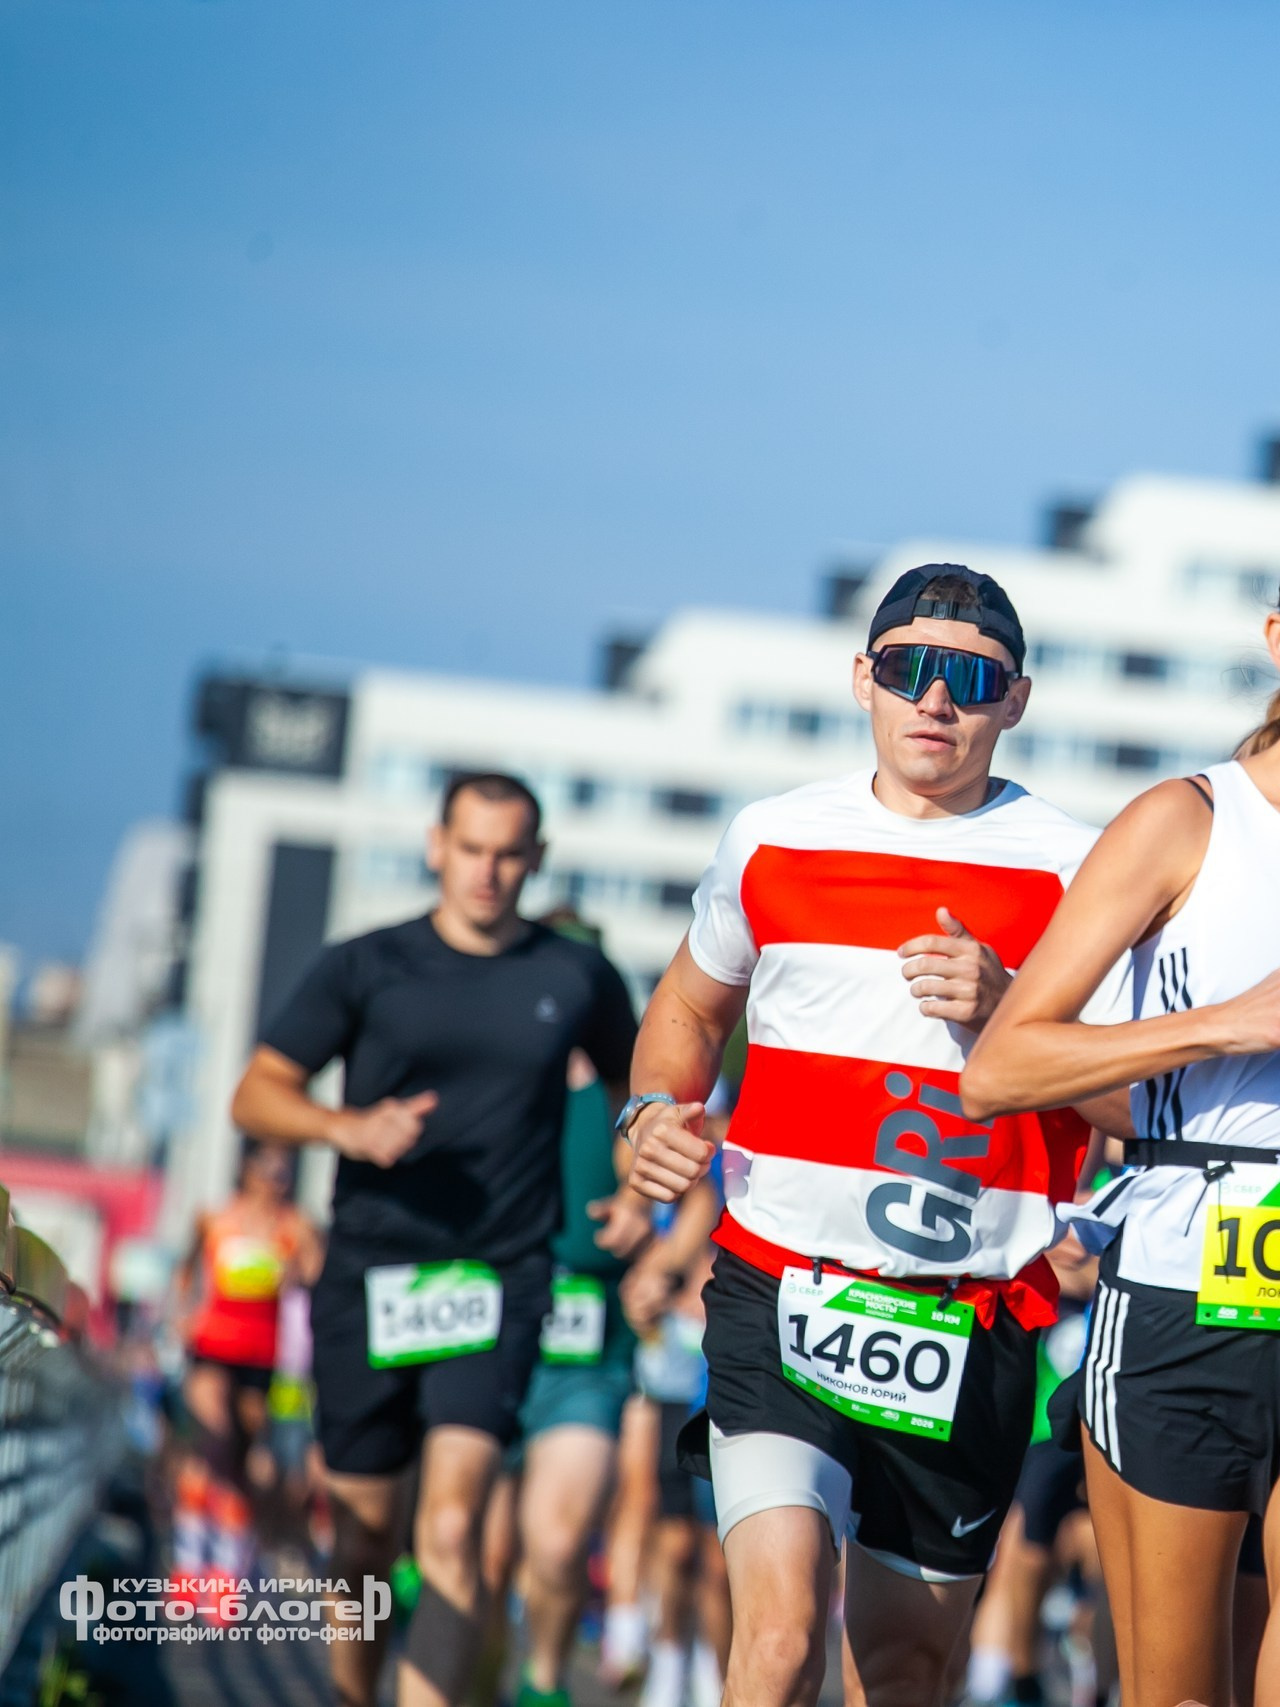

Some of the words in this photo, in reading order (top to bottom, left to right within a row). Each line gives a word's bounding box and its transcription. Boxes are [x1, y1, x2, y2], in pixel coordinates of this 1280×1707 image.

[788, 1314, 950, 1393] 1460
[816, 1371, 869, 1395] НИКОНОВ
[871, 1388, 907, 1403] ЮРИЙ
